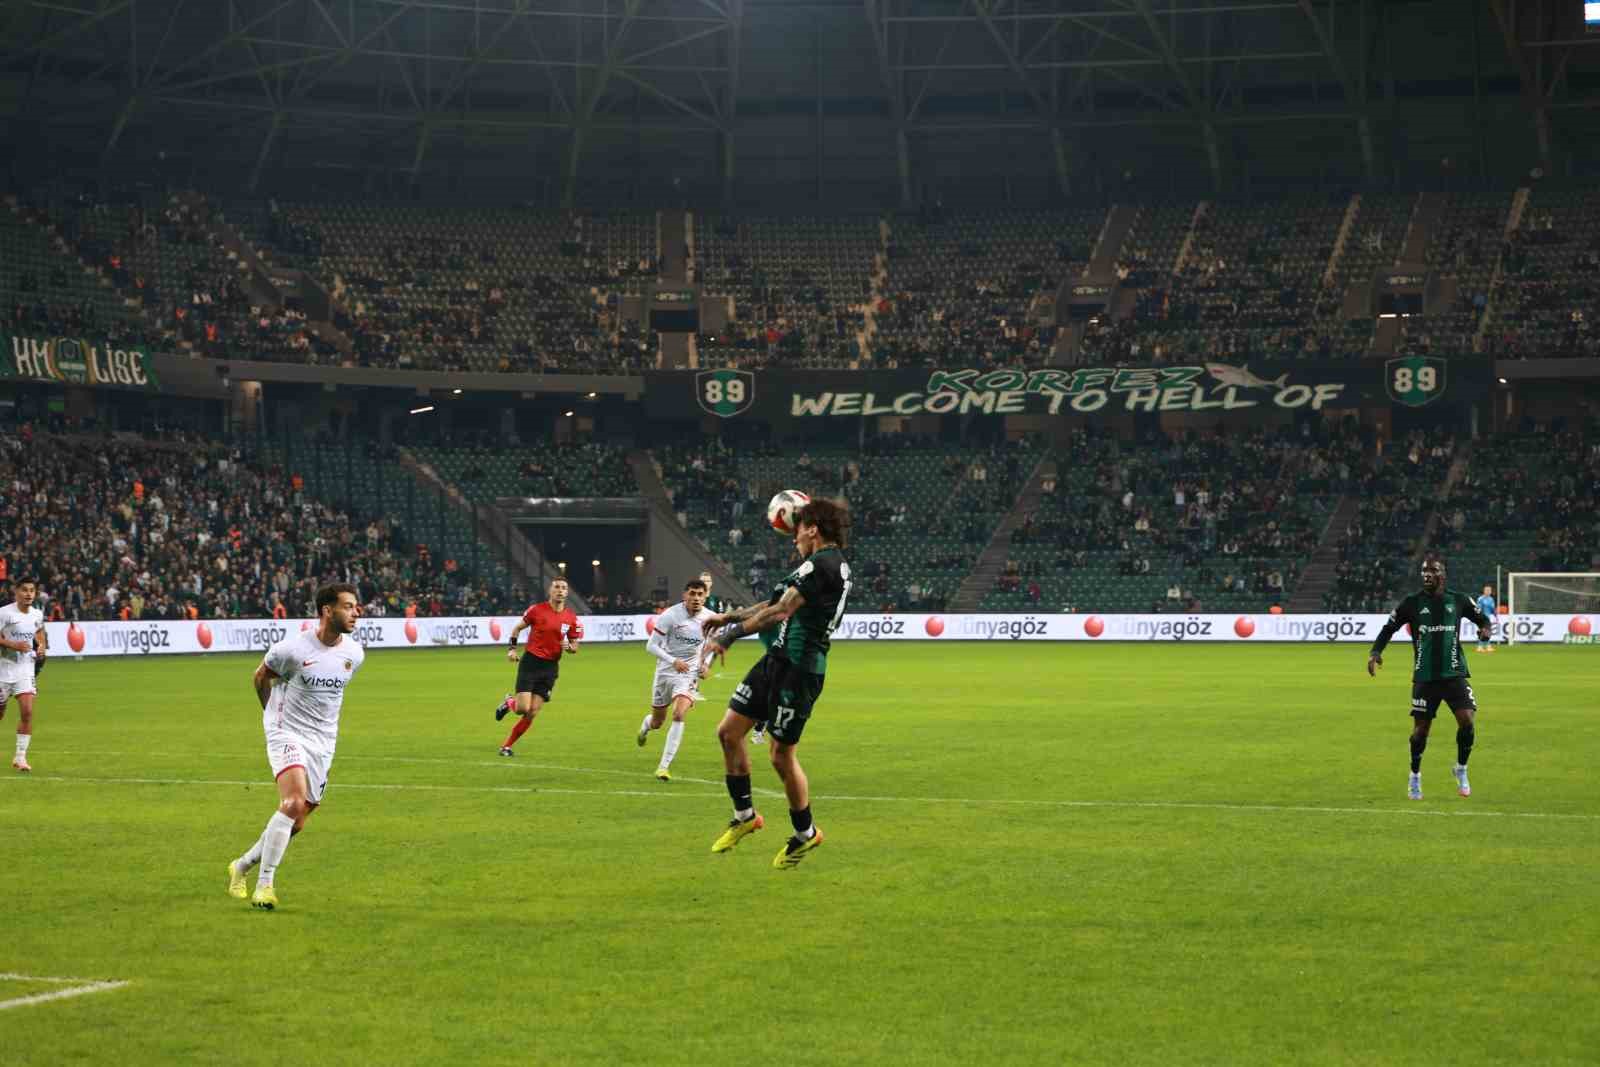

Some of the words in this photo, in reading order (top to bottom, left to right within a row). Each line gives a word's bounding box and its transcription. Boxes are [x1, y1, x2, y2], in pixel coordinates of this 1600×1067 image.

[704, 379, 745, 403] 89
[1393, 367, 1437, 392] 89
[790, 391, 1025, 416] WELCOME
[1041, 389, 1109, 415] TO
[1125, 386, 1258, 412] HELL
[1273, 384, 1345, 410] OF
[774, 705, 795, 729] 17
